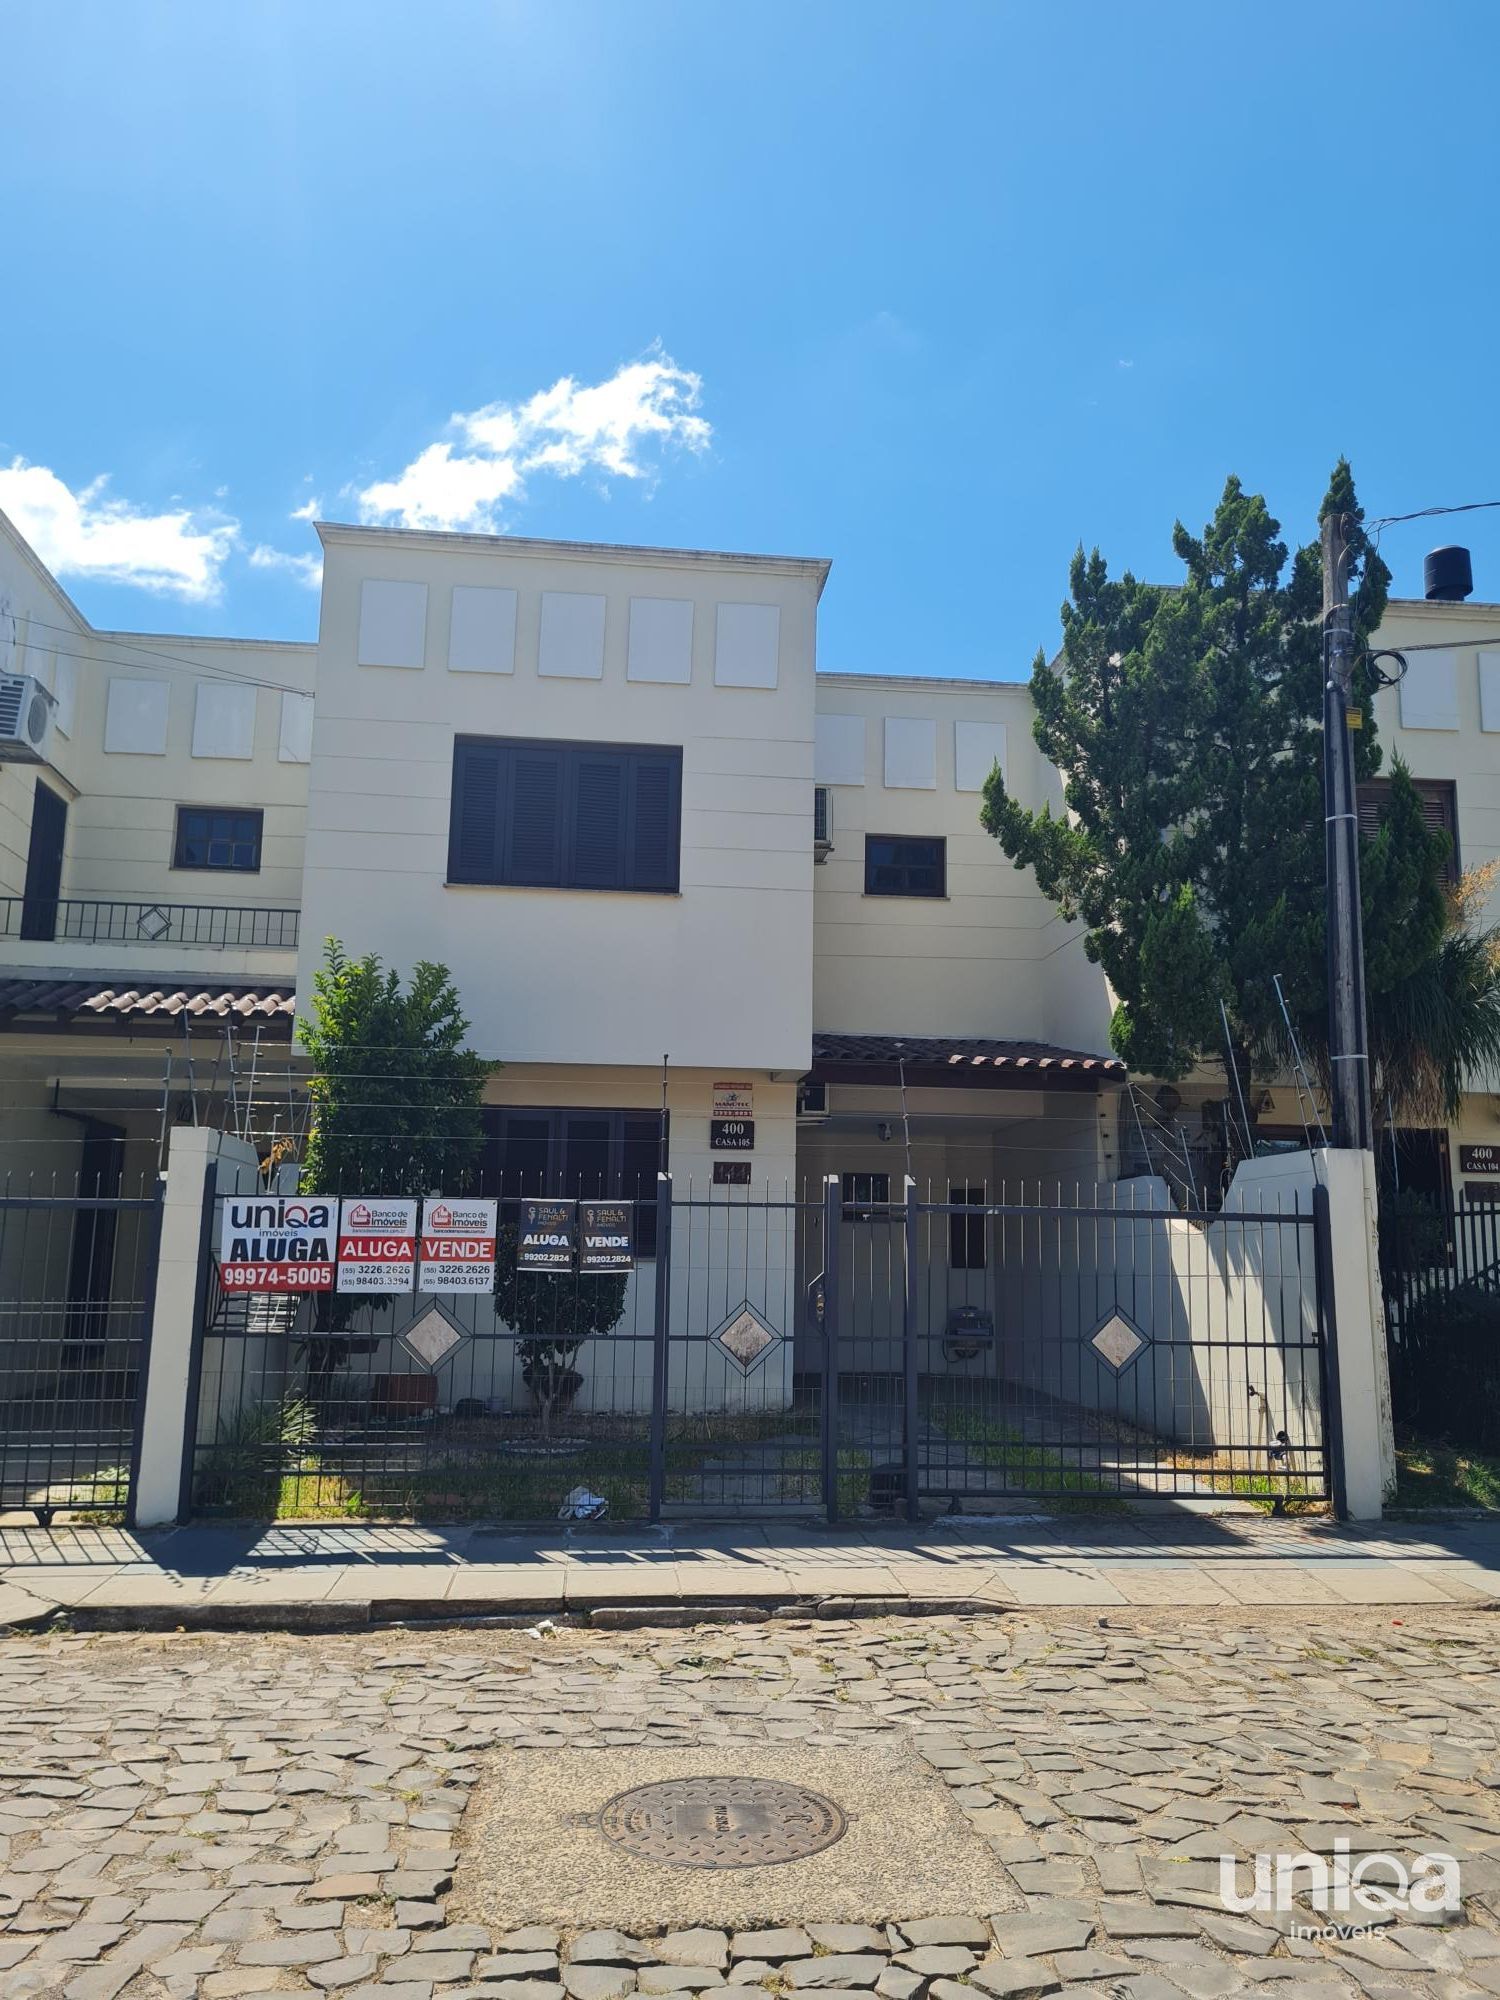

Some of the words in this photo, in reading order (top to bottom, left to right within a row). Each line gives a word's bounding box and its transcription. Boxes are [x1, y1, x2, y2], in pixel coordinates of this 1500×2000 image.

[722, 1122, 744, 1135] 400
[715, 1138, 736, 1146] CASA
[1472, 1148, 1493, 1159] 400
[1467, 1162, 1486, 1170] CASA
[371, 1210, 397, 1218] Banco
[371, 1218, 408, 1226] Imóveis
[452, 1219, 488, 1227] Imóveis
[259, 1229, 299, 1237] imóveis
[523, 1234, 569, 1247] ALUGA
[585, 1236, 629, 1248] VENDE
[229, 1238, 330, 1262] ALUGA
[343, 1241, 412, 1257] ALUGA
[425, 1241, 492, 1258] VENDE
[524, 1253, 570, 1262] 99202.2824
[586, 1255, 632, 1263] 99202.2824
[358, 1265, 411, 1274] 3226.2626
[439, 1265, 490, 1274] 3226.2626
[224, 1267, 331, 1285] 99974-5005
[356, 1277, 409, 1285] 98403.3394
[437, 1277, 490, 1285] 98403.6137
